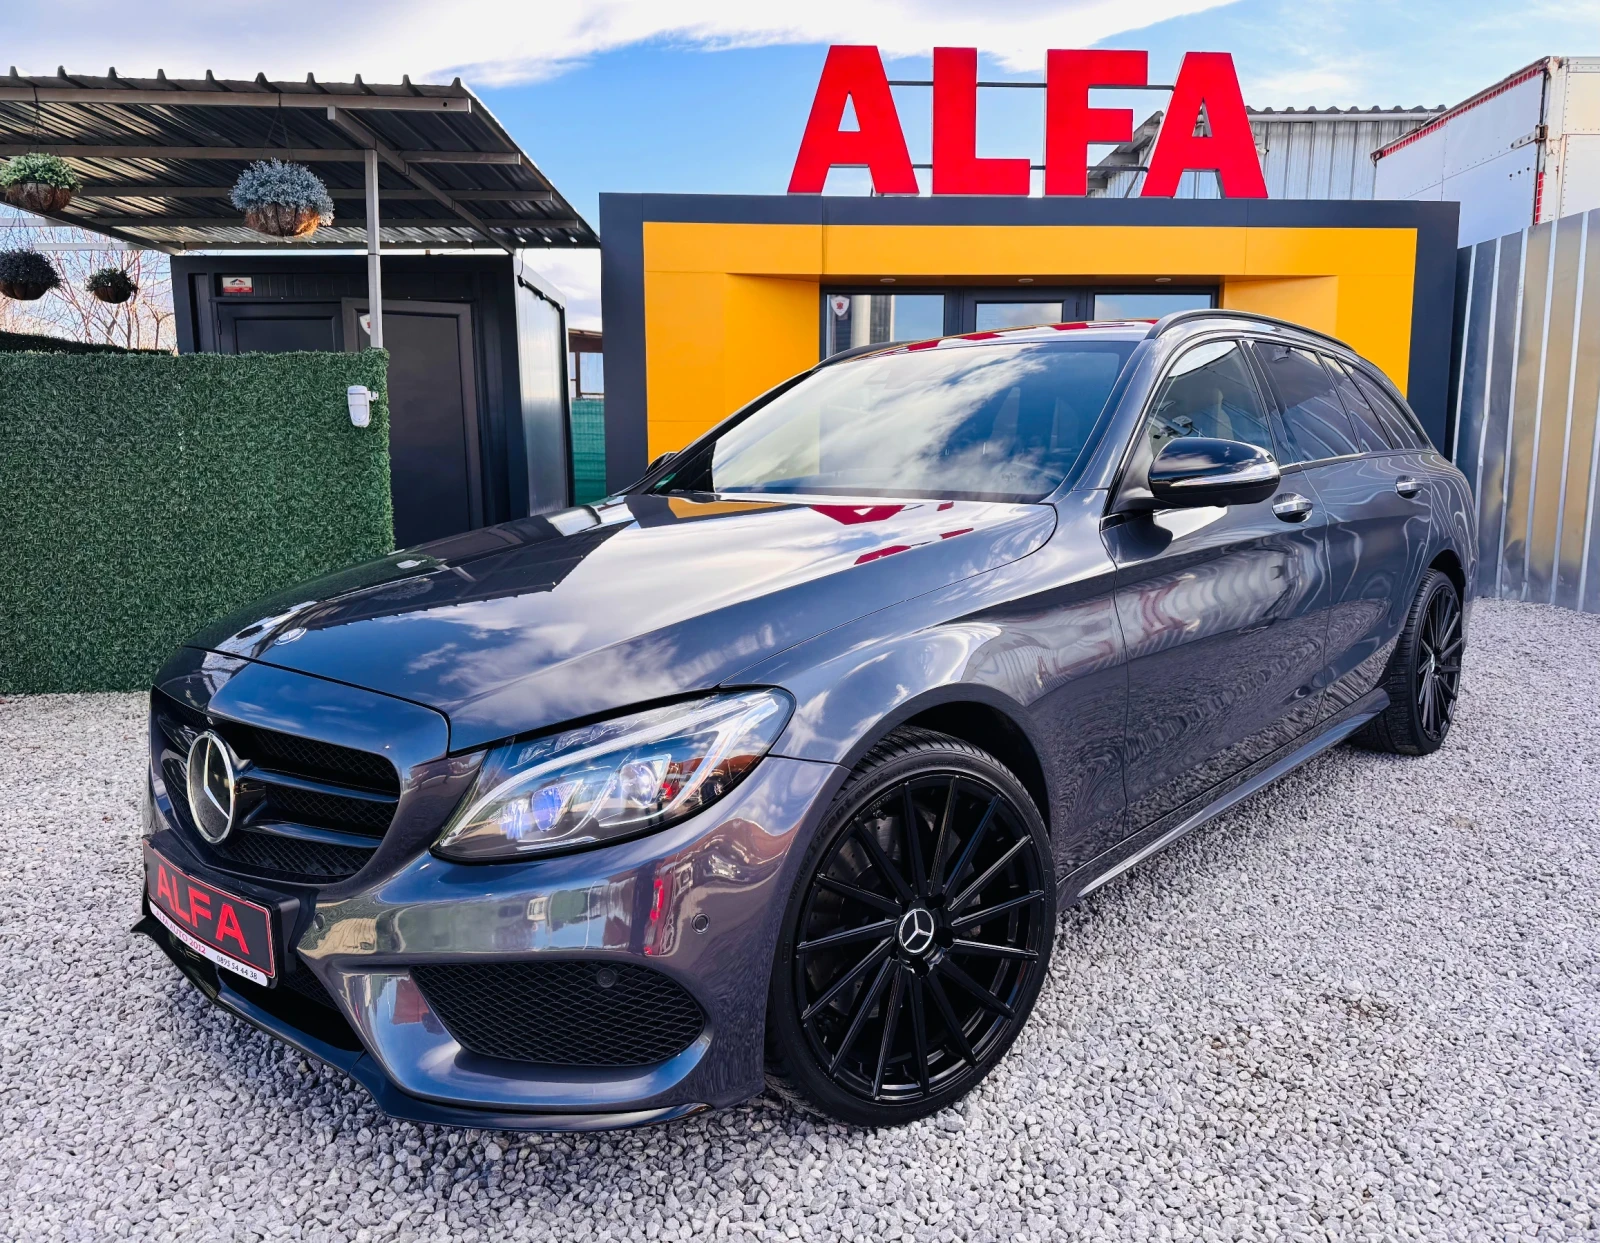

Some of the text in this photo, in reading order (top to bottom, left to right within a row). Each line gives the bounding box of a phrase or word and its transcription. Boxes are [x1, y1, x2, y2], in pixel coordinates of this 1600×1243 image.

[787, 44, 1268, 198] ALFA
[155, 909, 207, 955] ALFA AUTO 2012
[157, 864, 250, 955] ALFA
[216, 954, 258, 980] 0895 54 44 38
